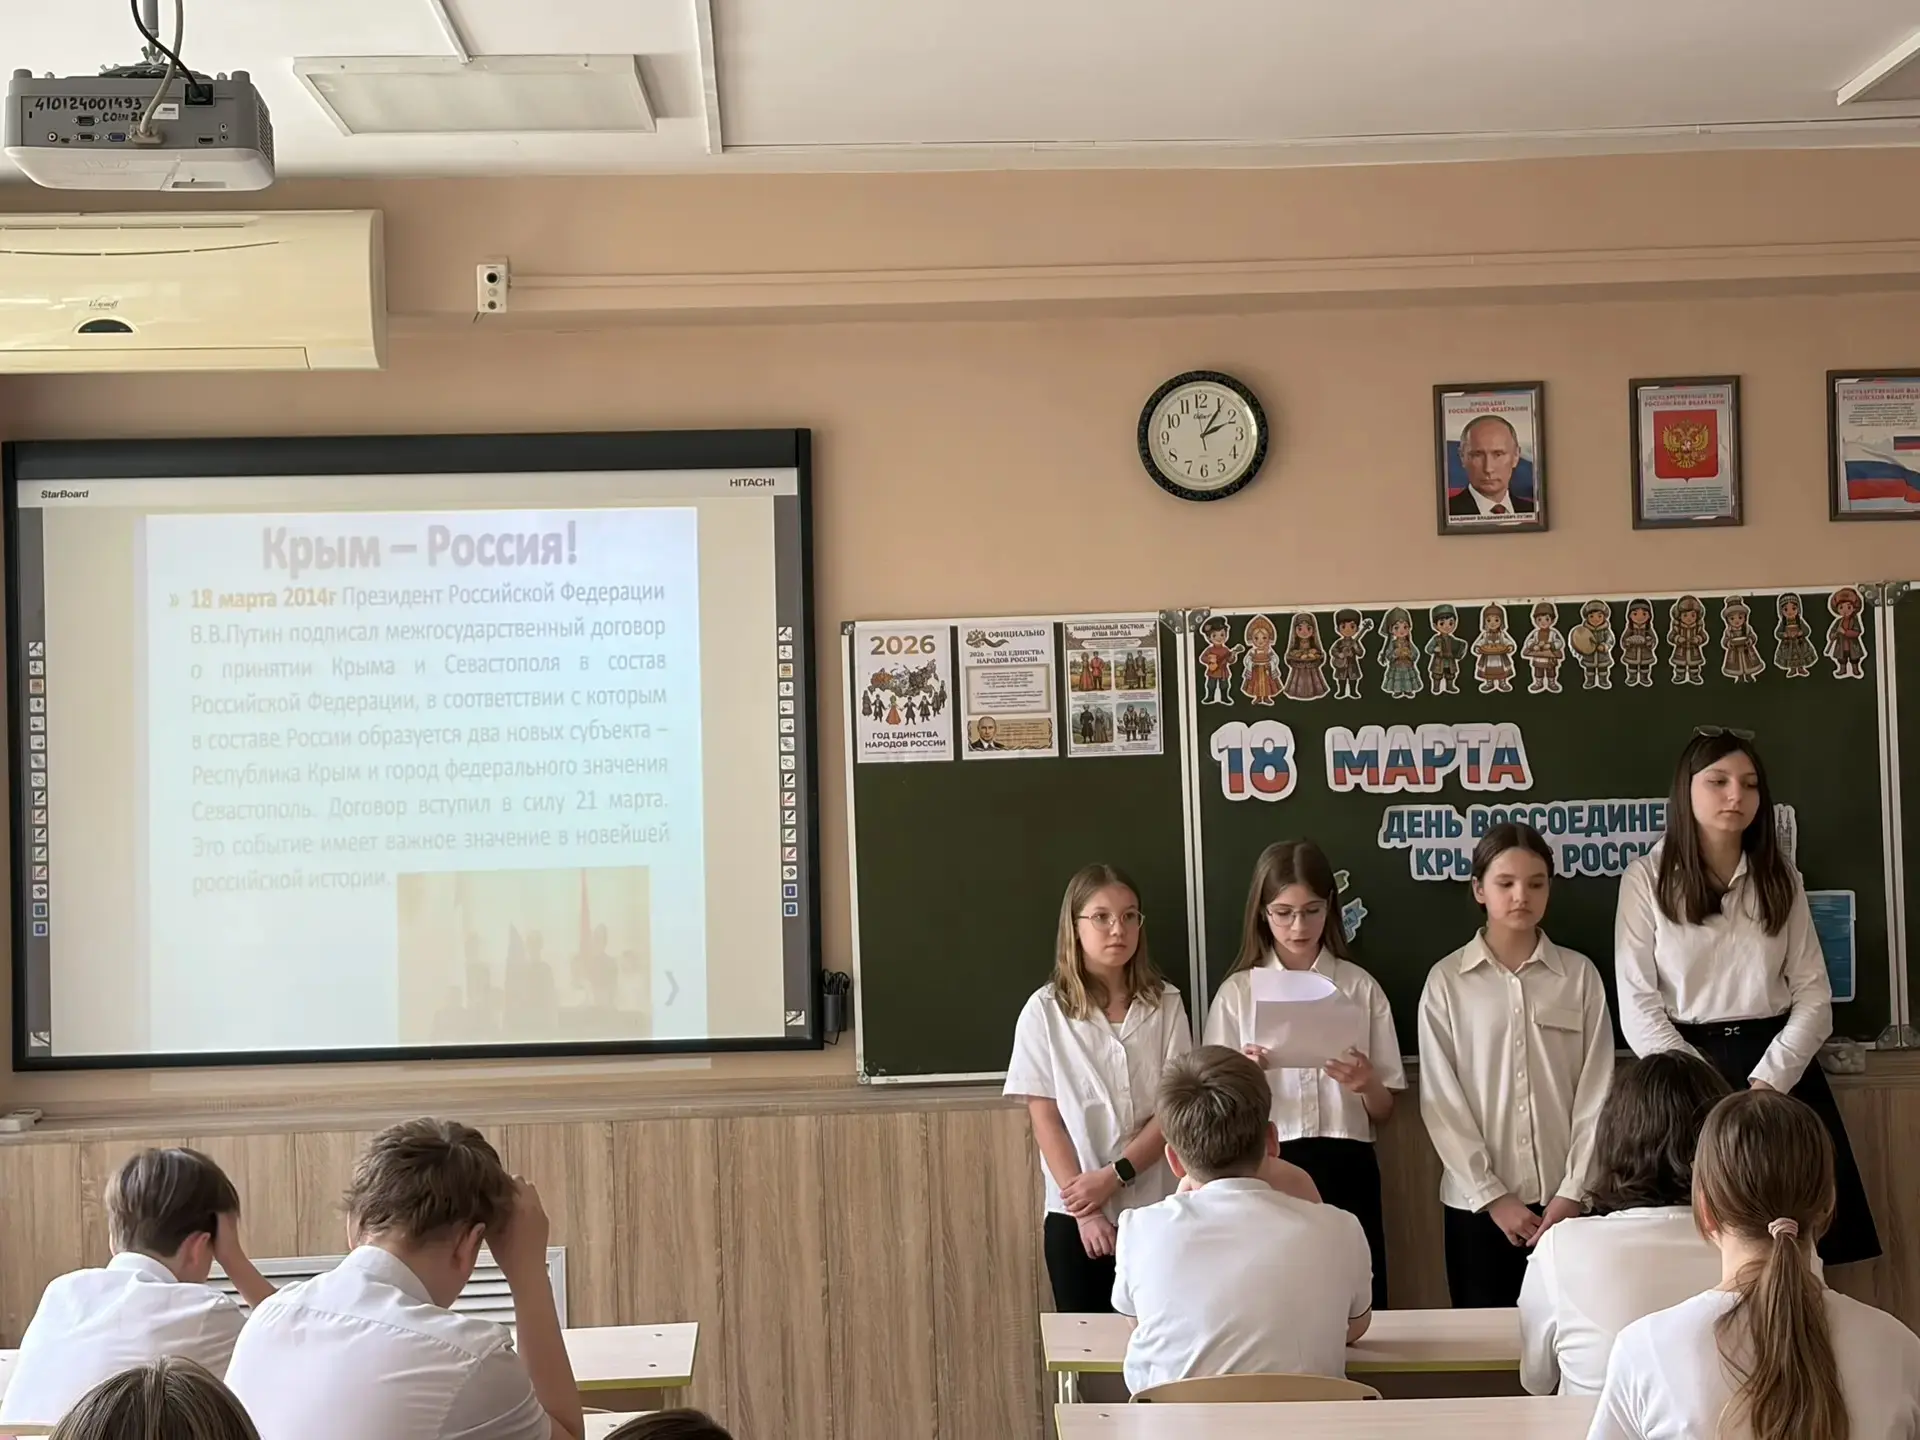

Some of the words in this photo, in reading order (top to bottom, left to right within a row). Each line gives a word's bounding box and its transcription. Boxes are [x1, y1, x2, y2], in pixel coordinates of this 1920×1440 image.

[35, 97, 142, 111] 410124001493
[1180, 399, 1190, 414] 11
[1194, 393, 1208, 408] 12
[1167, 413, 1181, 429] 10
[1228, 408, 1237, 424] 2
[1161, 430, 1170, 445] 9
[1235, 426, 1244, 441] 3
[1168, 448, 1178, 462] 8
[1229, 444, 1239, 459] 4
[1184, 460, 1193, 475] 7
[1200, 464, 1209, 478] 6
[1217, 458, 1226, 472] 5
[729, 477, 775, 488] HITACHI
[40, 489, 89, 500] StarBoard
[262, 525, 381, 580] Крым
[427, 520, 578, 567] Россия!
[191, 588, 213, 609] 18
[218, 591, 278, 612] марта
[283, 585, 337, 607] 2014г
[342, 585, 443, 611] Президент
[448, 581, 554, 604] Российской
[560, 583, 664, 605] Федерации
[190, 623, 283, 648] В.В.Путин
[289, 623, 379, 646] подписал
[385, 616, 585, 643] межгосударственный
[590, 618, 666, 643] договор
[988, 629, 1046, 638] ОФИЦИАЛЬНО
[870, 635, 936, 655] 2026
[1008, 649, 1045, 657] ЕДИНСТВА
[191, 663, 203, 680] о
[222, 660, 313, 685] принятии
[332, 656, 395, 681] Крыма
[415, 657, 426, 675] и
[444, 653, 561, 674] Севастополя
[579, 655, 590, 671] в
[608, 653, 666, 671] состав
[191, 692, 300, 715] Российской
[308, 691, 420, 717] Федерации,
[426, 693, 437, 709] в
[443, 690, 564, 709] соответствии
[571, 690, 582, 707] с
[586, 687, 668, 710] которым
[191, 734, 202, 750] в
[208, 731, 281, 750] составе
[287, 728, 350, 748] России
[357, 723, 461, 749] образуется
[467, 726, 500, 747] два
[507, 723, 565, 742] новых
[570, 718, 651, 744] субъекта
[872, 732, 890, 740] ГОД
[892, 731, 939, 739] ЕДИНСТВА
[865, 740, 909, 749] НАРОДОВ
[910, 739, 946, 747] РОССИИ
[1216, 726, 1292, 794] 18
[1331, 728, 1527, 787] МАРТА
[192, 763, 300, 790] Республика
[308, 761, 361, 787] Крым
[368, 763, 379, 780] и
[385, 762, 440, 784] город
[445, 757, 578, 785] федерального
[582, 757, 668, 776] значения
[191, 800, 318, 821] Севастополь.
[328, 797, 407, 823] Договор
[419, 796, 491, 818] вступил
[502, 797, 512, 812] в
[523, 794, 565, 814] силу
[576, 789, 598, 810] 21
[609, 792, 669, 813] марта.
[1383, 808, 1463, 844] ДЕНЬ
[1471, 803, 1670, 838] ВОССОЕДИНЕ
[191, 836, 225, 858] Это
[232, 832, 313, 856] событие
[320, 835, 379, 851] имеет
[385, 831, 457, 851] важное
[463, 829, 551, 849] значение
[558, 829, 569, 845] в
[576, 820, 670, 845] новейшей
[192, 866, 303, 899] российской
[308, 870, 391, 892] истории.
